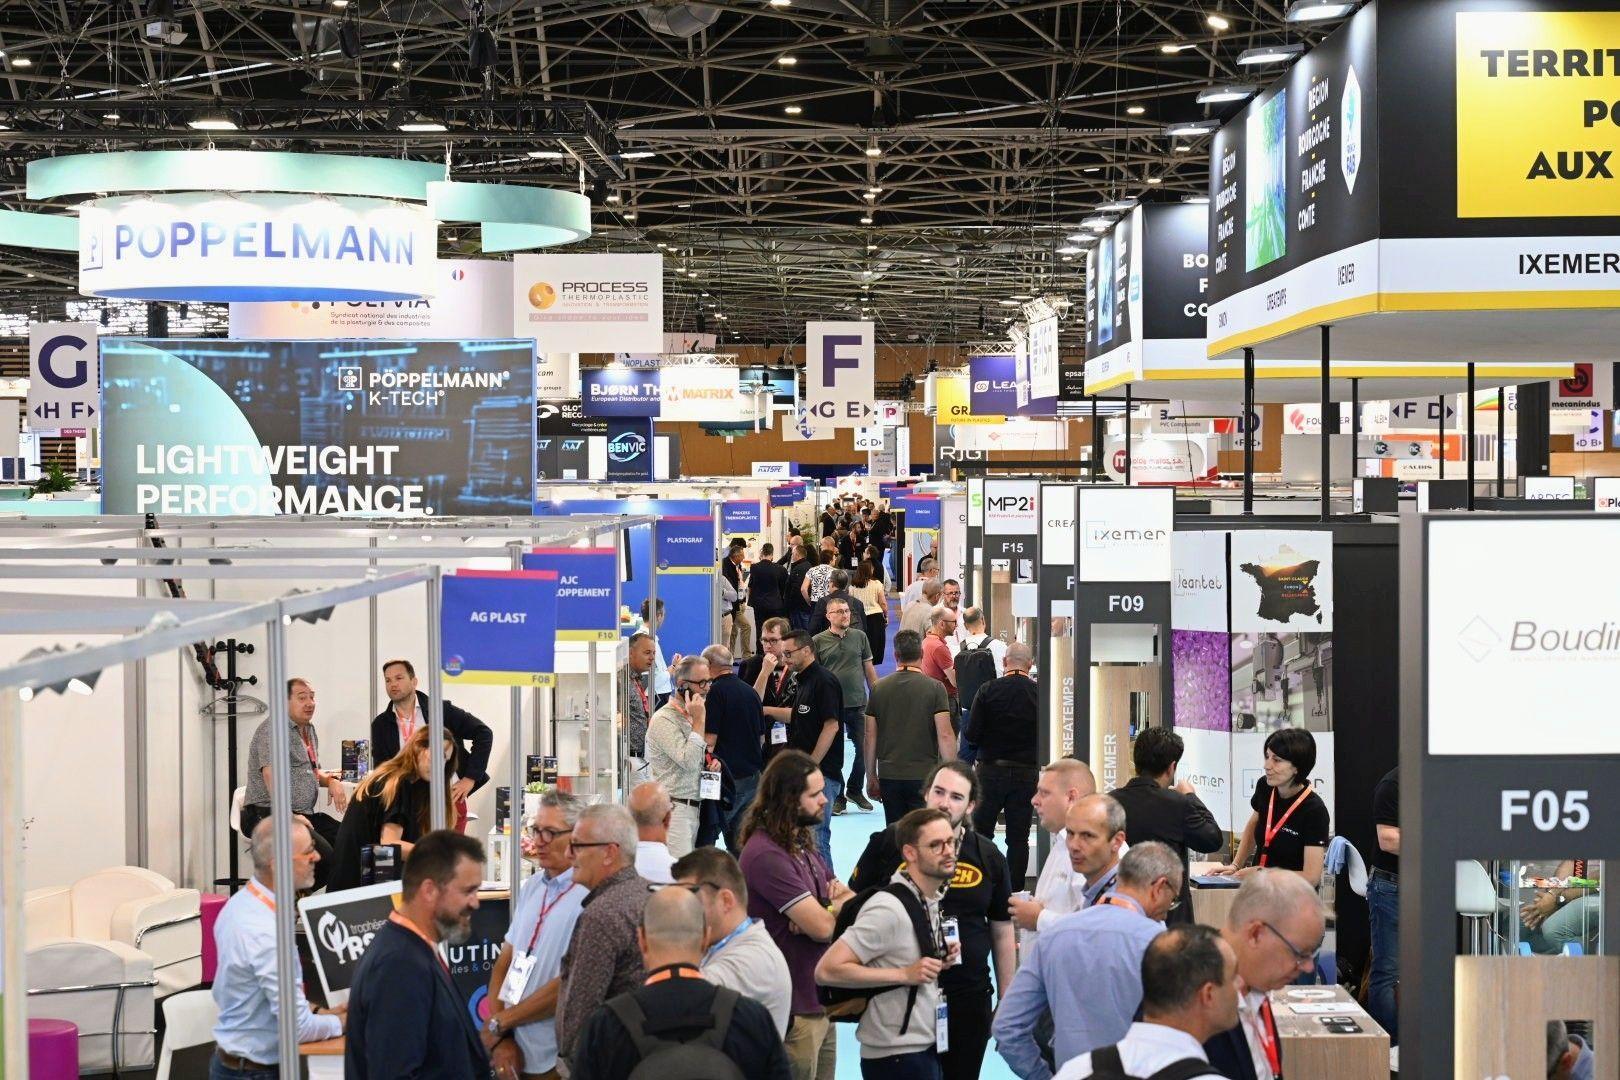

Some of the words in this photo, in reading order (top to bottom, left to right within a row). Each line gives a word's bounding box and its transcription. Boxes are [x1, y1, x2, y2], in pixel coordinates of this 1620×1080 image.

[1526, 150, 1614, 180] AUX
[1301, 158, 1326, 193] FRANCHE
[1183, 253, 1208, 268] BO
[1519, 252, 1620, 275] IXEMER
[562, 282, 648, 293] PROCESS
[37, 335, 88, 389] G
[822, 335, 863, 387] F
[590, 384, 639, 396] BJØRN
[682, 388, 734, 400] MATRIX
[44, 402, 60, 419] H
[71, 402, 84, 419] F
[819, 400, 835, 418] G
[846, 401, 860, 418] E
[951, 405, 970, 415] GR
[1404, 402, 1417, 419] F
[1551, 400, 1600, 408] mecanindus
[1306, 416, 1350, 425] FOUER
[607, 442, 646, 453] BENVIC
[859, 438, 867, 447] G
[870, 438, 879, 447] D
[1579, 439, 1587, 447] D
[1590, 439, 1598, 447] B
[136, 444, 400, 476] LIGHTWEIGHT
[940, 446, 981, 462] RJG
[136, 484, 435, 517] PERFORMANCE.
[988, 496, 1034, 511] MP2i
[1002, 542, 1024, 553] F15
[560, 575, 578, 585] AJC
[556, 587, 611, 598] OPPEMENT
[1109, 595, 1144, 612] F09
[470, 611, 488, 623] AG
[489, 612, 527, 624] PLAST
[598, 631, 613, 639] F10
[531, 675, 550, 684] F08
[1104, 733, 1117, 794] XEMER
[1501, 789, 1590, 832] F05
[472, 963, 479, 972] &
